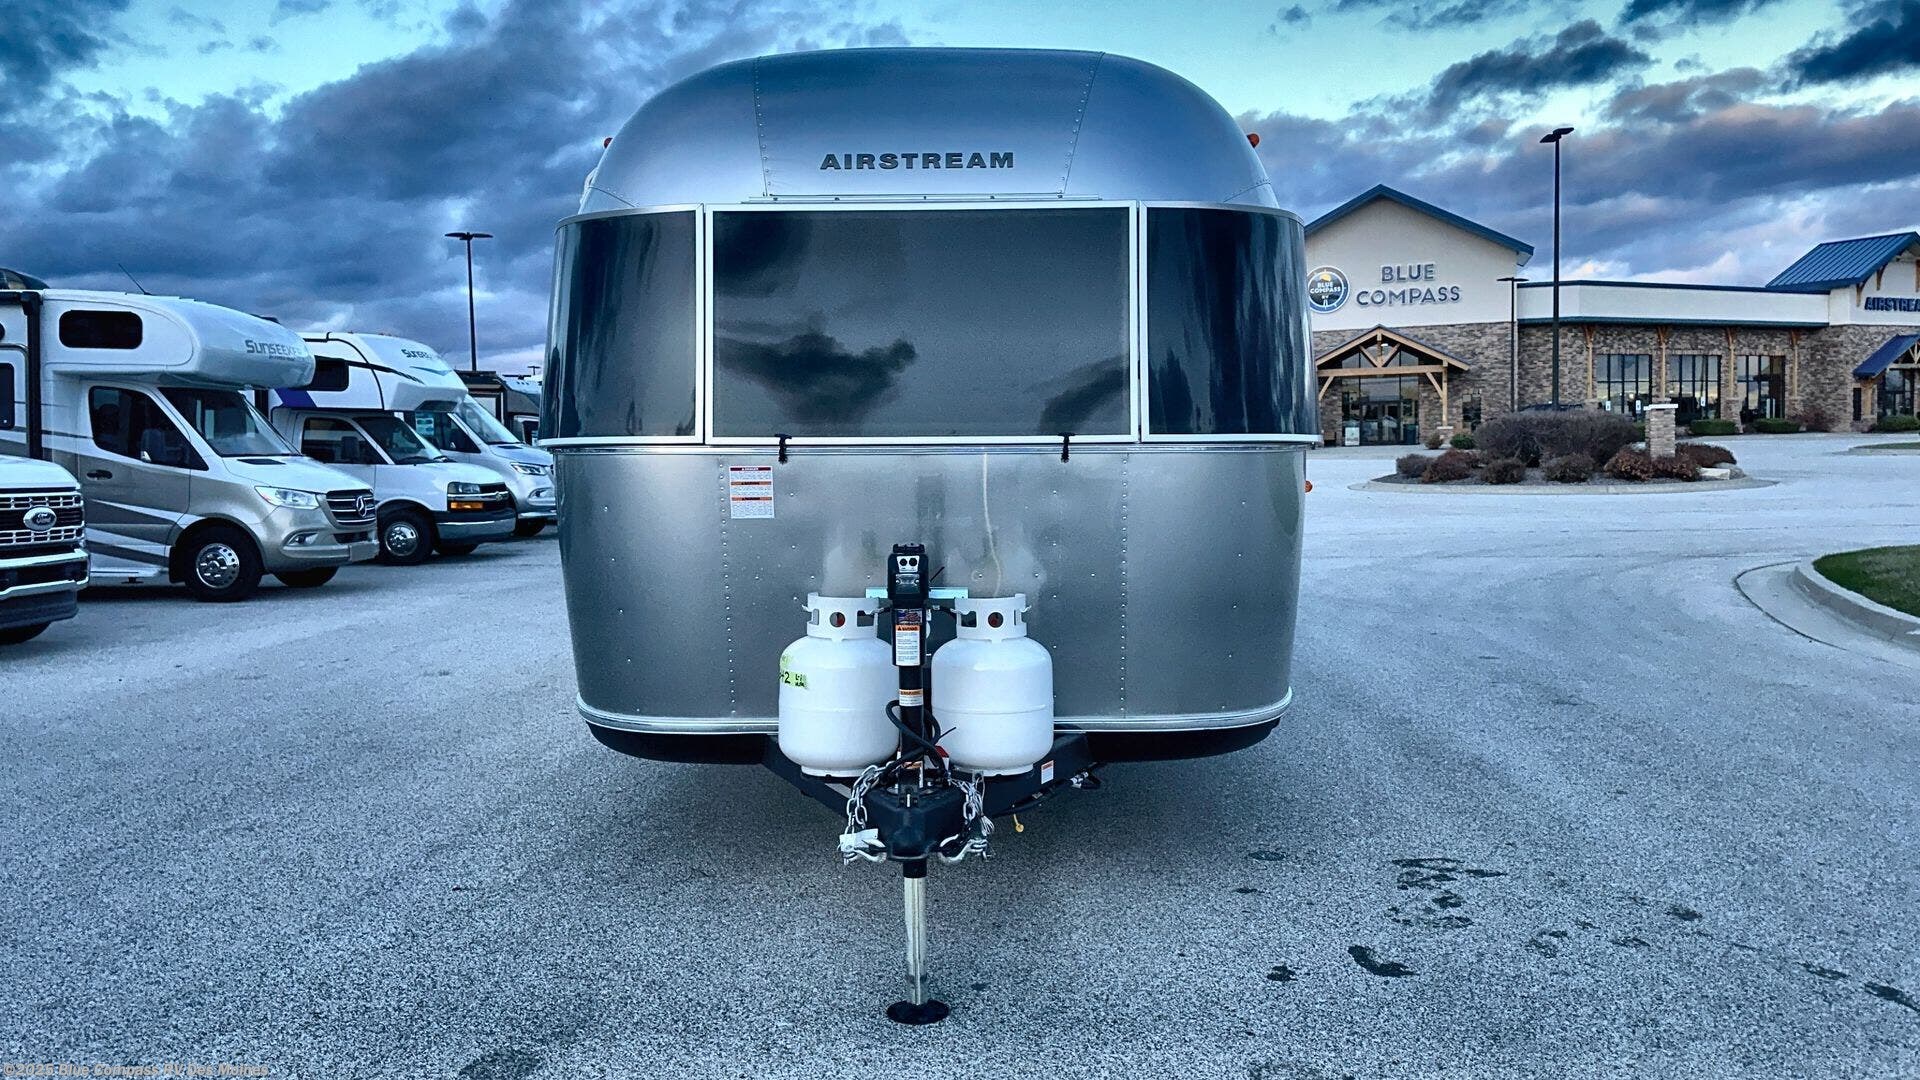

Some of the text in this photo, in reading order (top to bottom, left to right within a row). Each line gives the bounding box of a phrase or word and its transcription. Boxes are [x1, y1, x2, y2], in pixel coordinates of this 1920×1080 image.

[820, 152, 1014, 170] AIRSTREAM
[1381, 264, 1434, 281] BLUE
[1309, 286, 1341, 294] COMPASS
[1356, 286, 1460, 306] COMPASS
